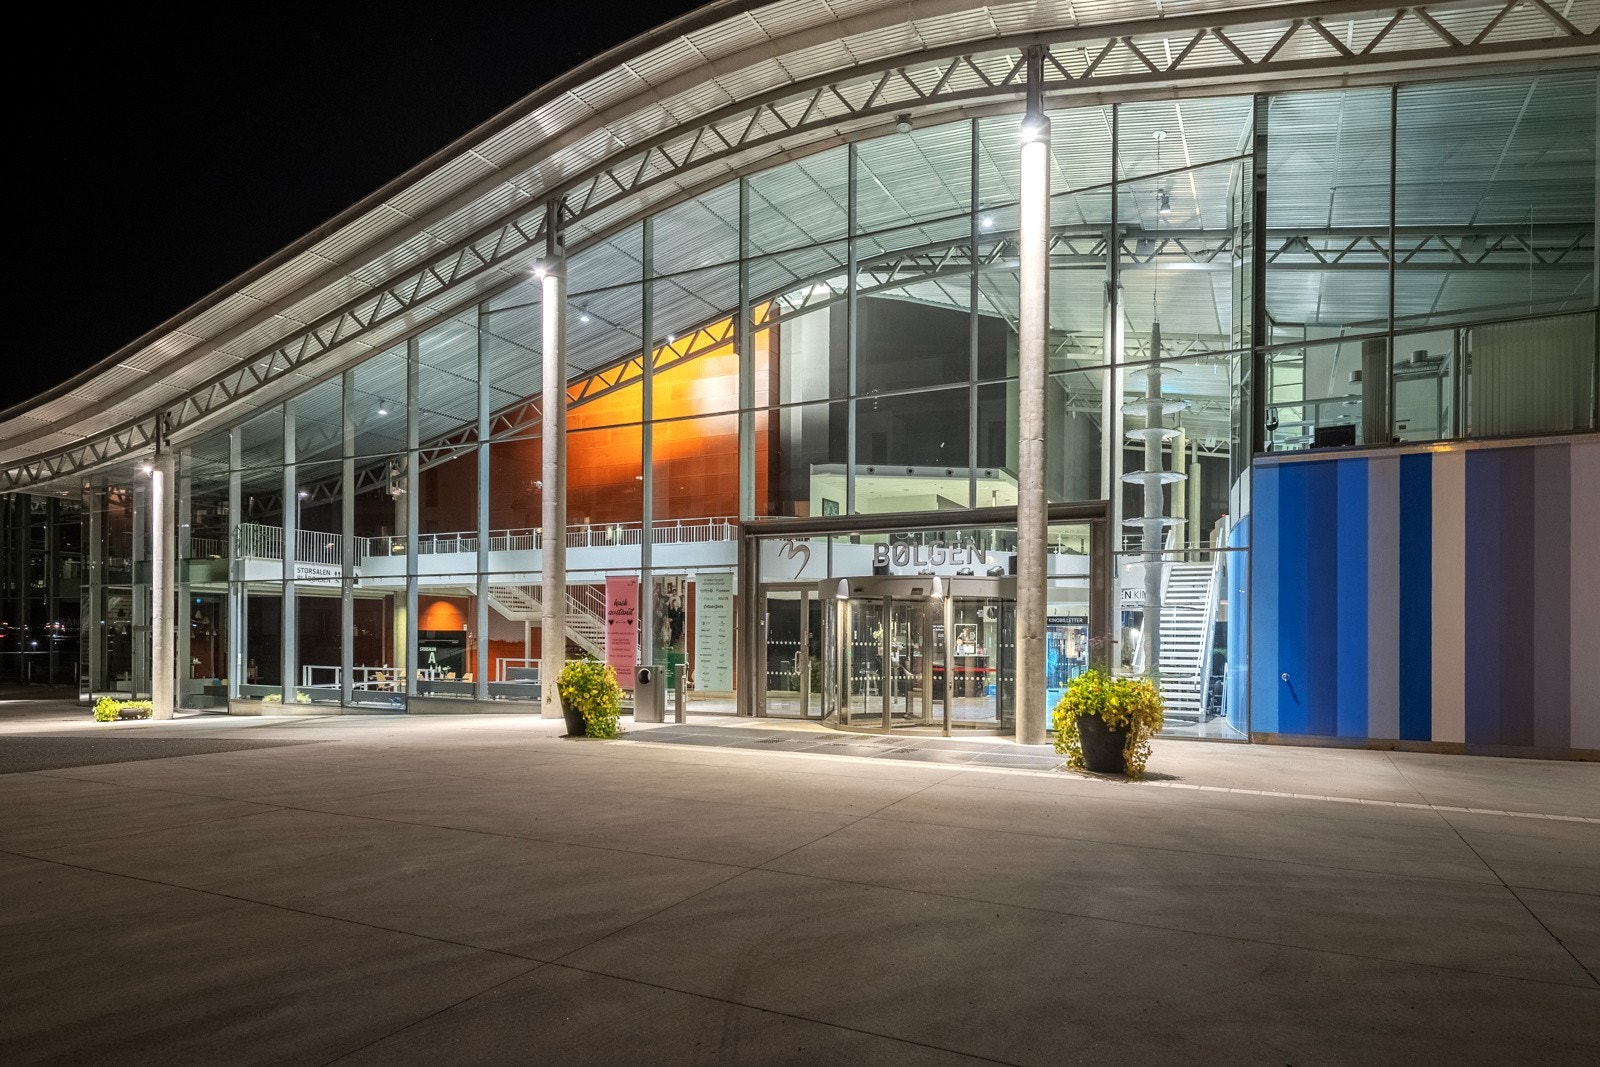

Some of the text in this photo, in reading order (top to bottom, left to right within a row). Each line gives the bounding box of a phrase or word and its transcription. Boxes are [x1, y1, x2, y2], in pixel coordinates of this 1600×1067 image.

[873, 540, 986, 567] BØLGEN
[297, 566, 331, 576] STORSALEN
[427, 651, 436, 663] A
